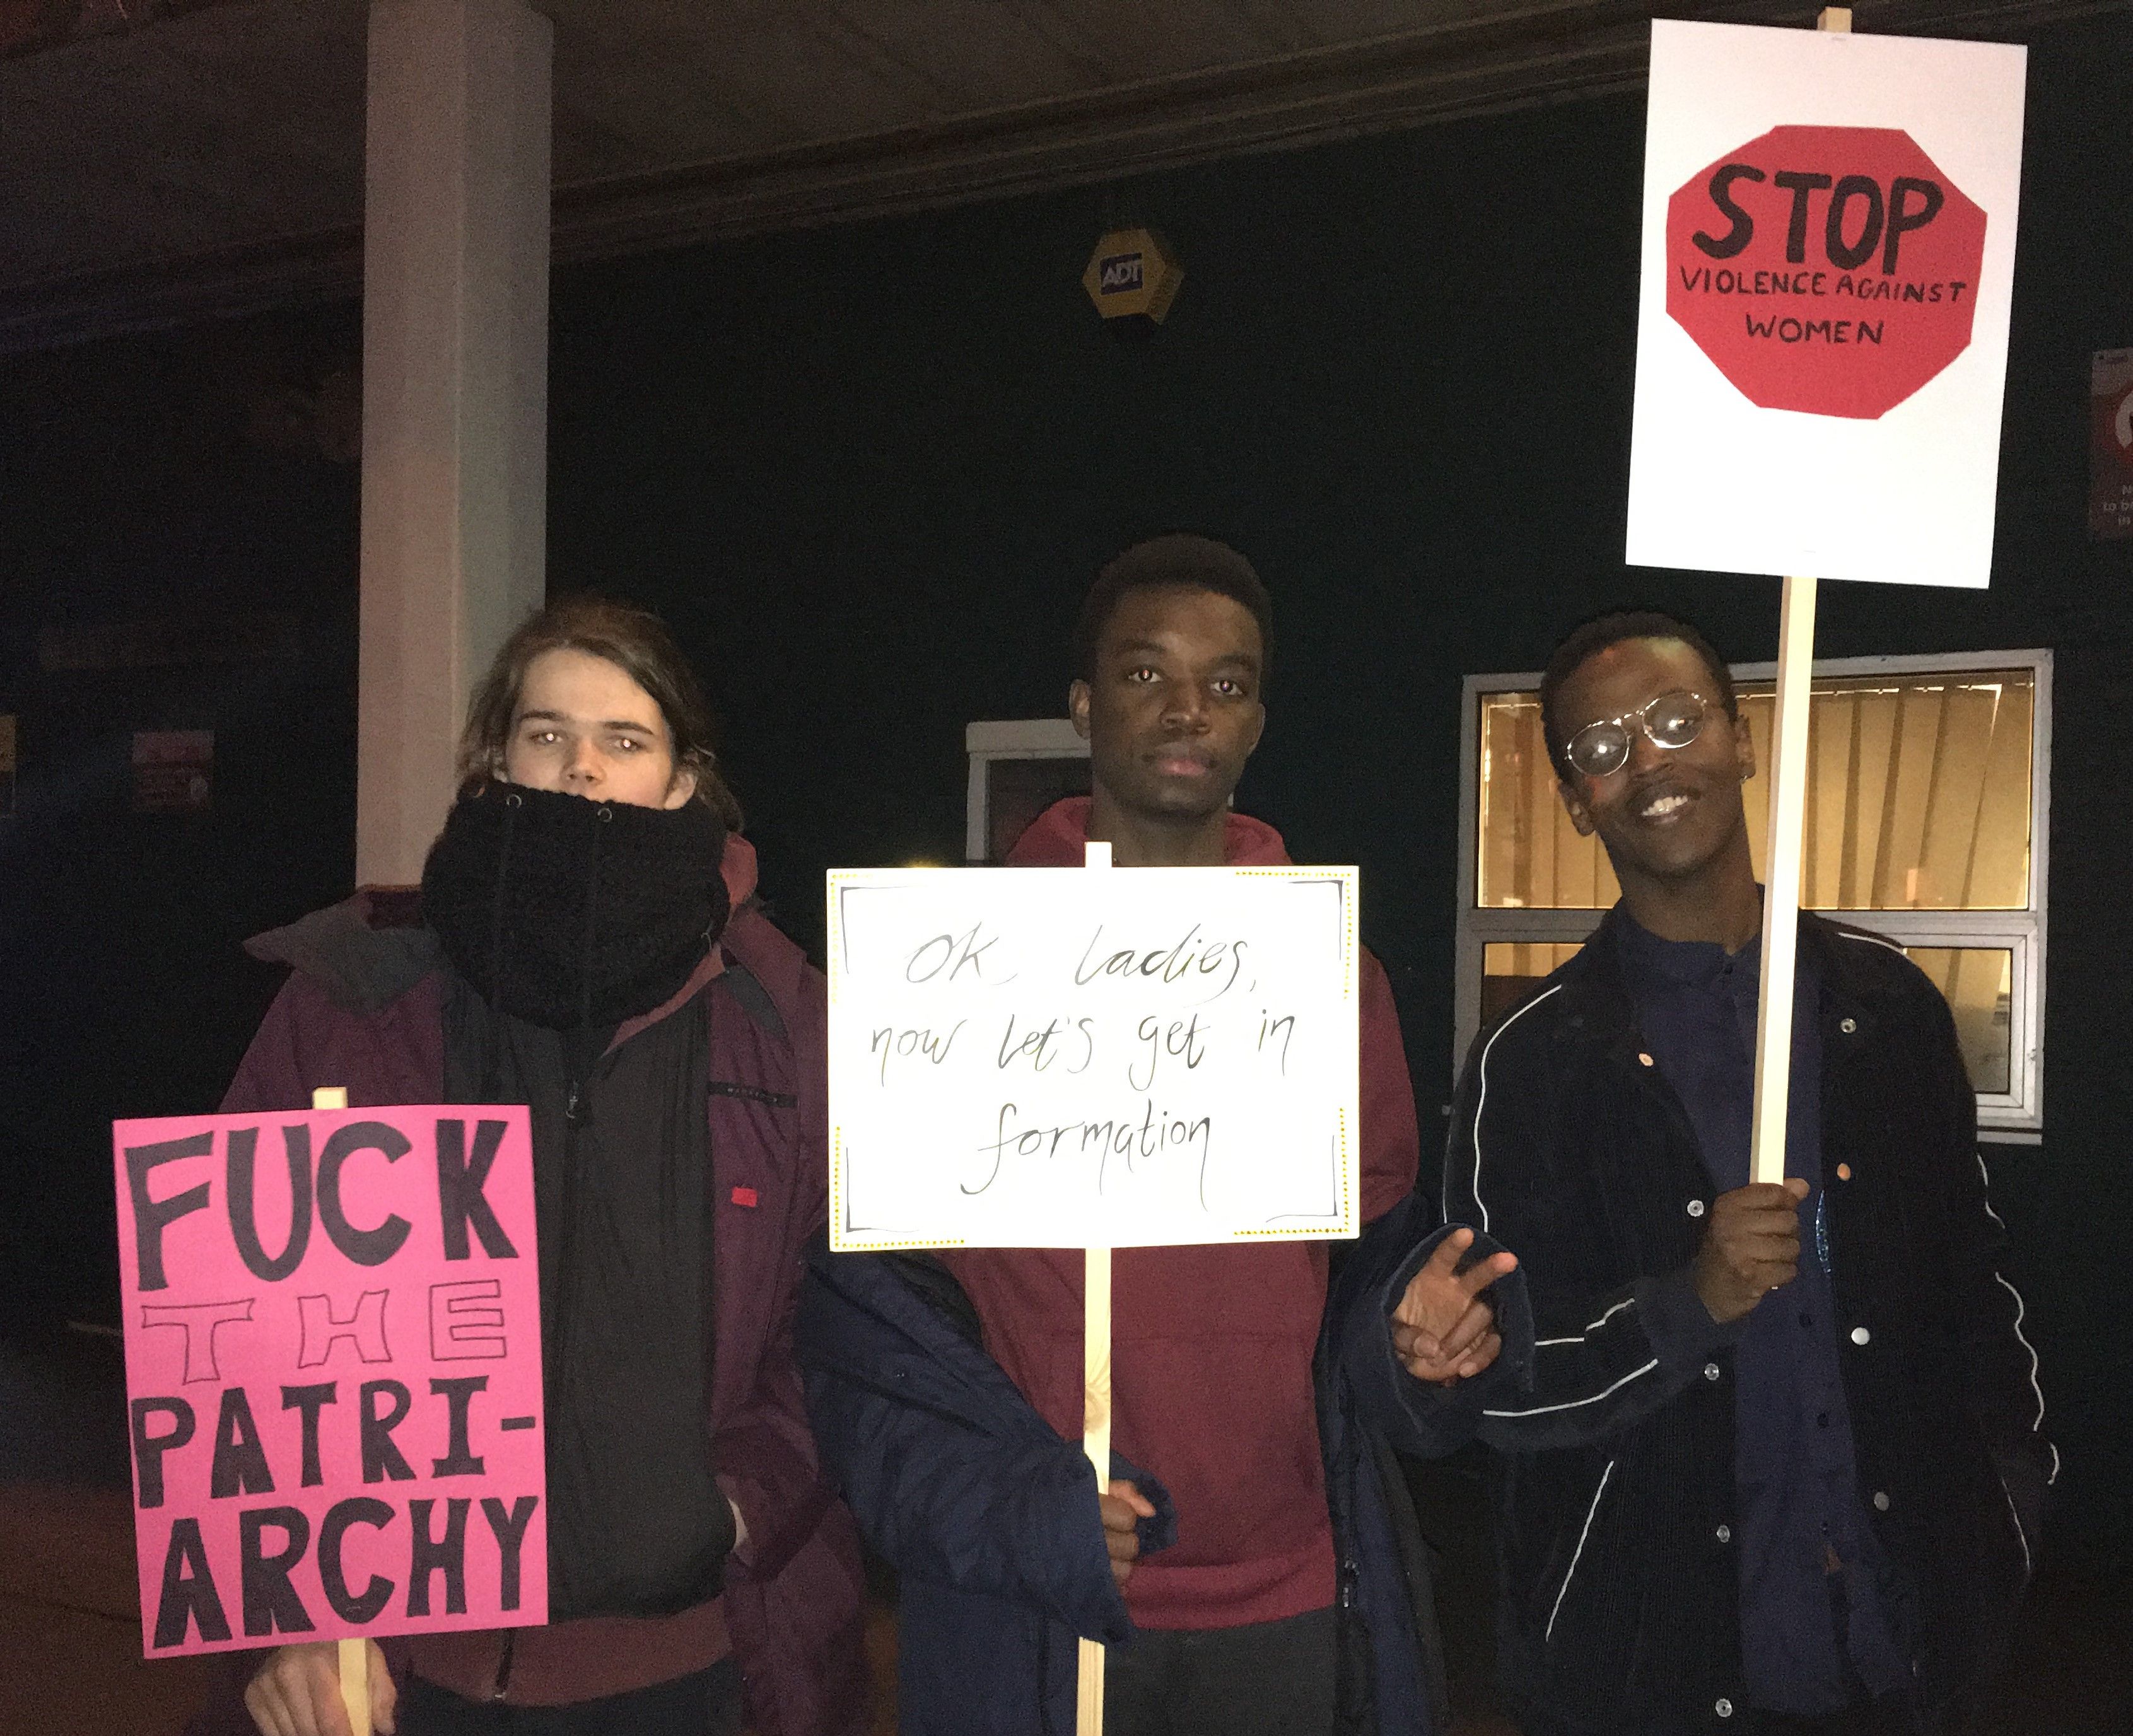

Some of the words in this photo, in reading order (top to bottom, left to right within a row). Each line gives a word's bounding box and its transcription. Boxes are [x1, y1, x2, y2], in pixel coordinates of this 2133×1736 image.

[1103, 259, 1143, 285] ADT
[1692, 163, 1946, 276] STOP
[1680, 265, 1828, 296] VIOLENCE
[1835, 274, 1968, 303] AGAINST
[1745, 313, 1885, 345] WOMEN
[870, 1017, 969, 1088] now
[1128, 1012, 1212, 1093] get
[1256, 1008, 1297, 1077] in
[124, 1119, 519, 1291] FUCK
[959, 1097, 1212, 1213] formation
[141, 1279, 507, 1385] THE
[130, 1375, 537, 1509] PATRI-
[152, 1495, 539, 1650] ARCHY
